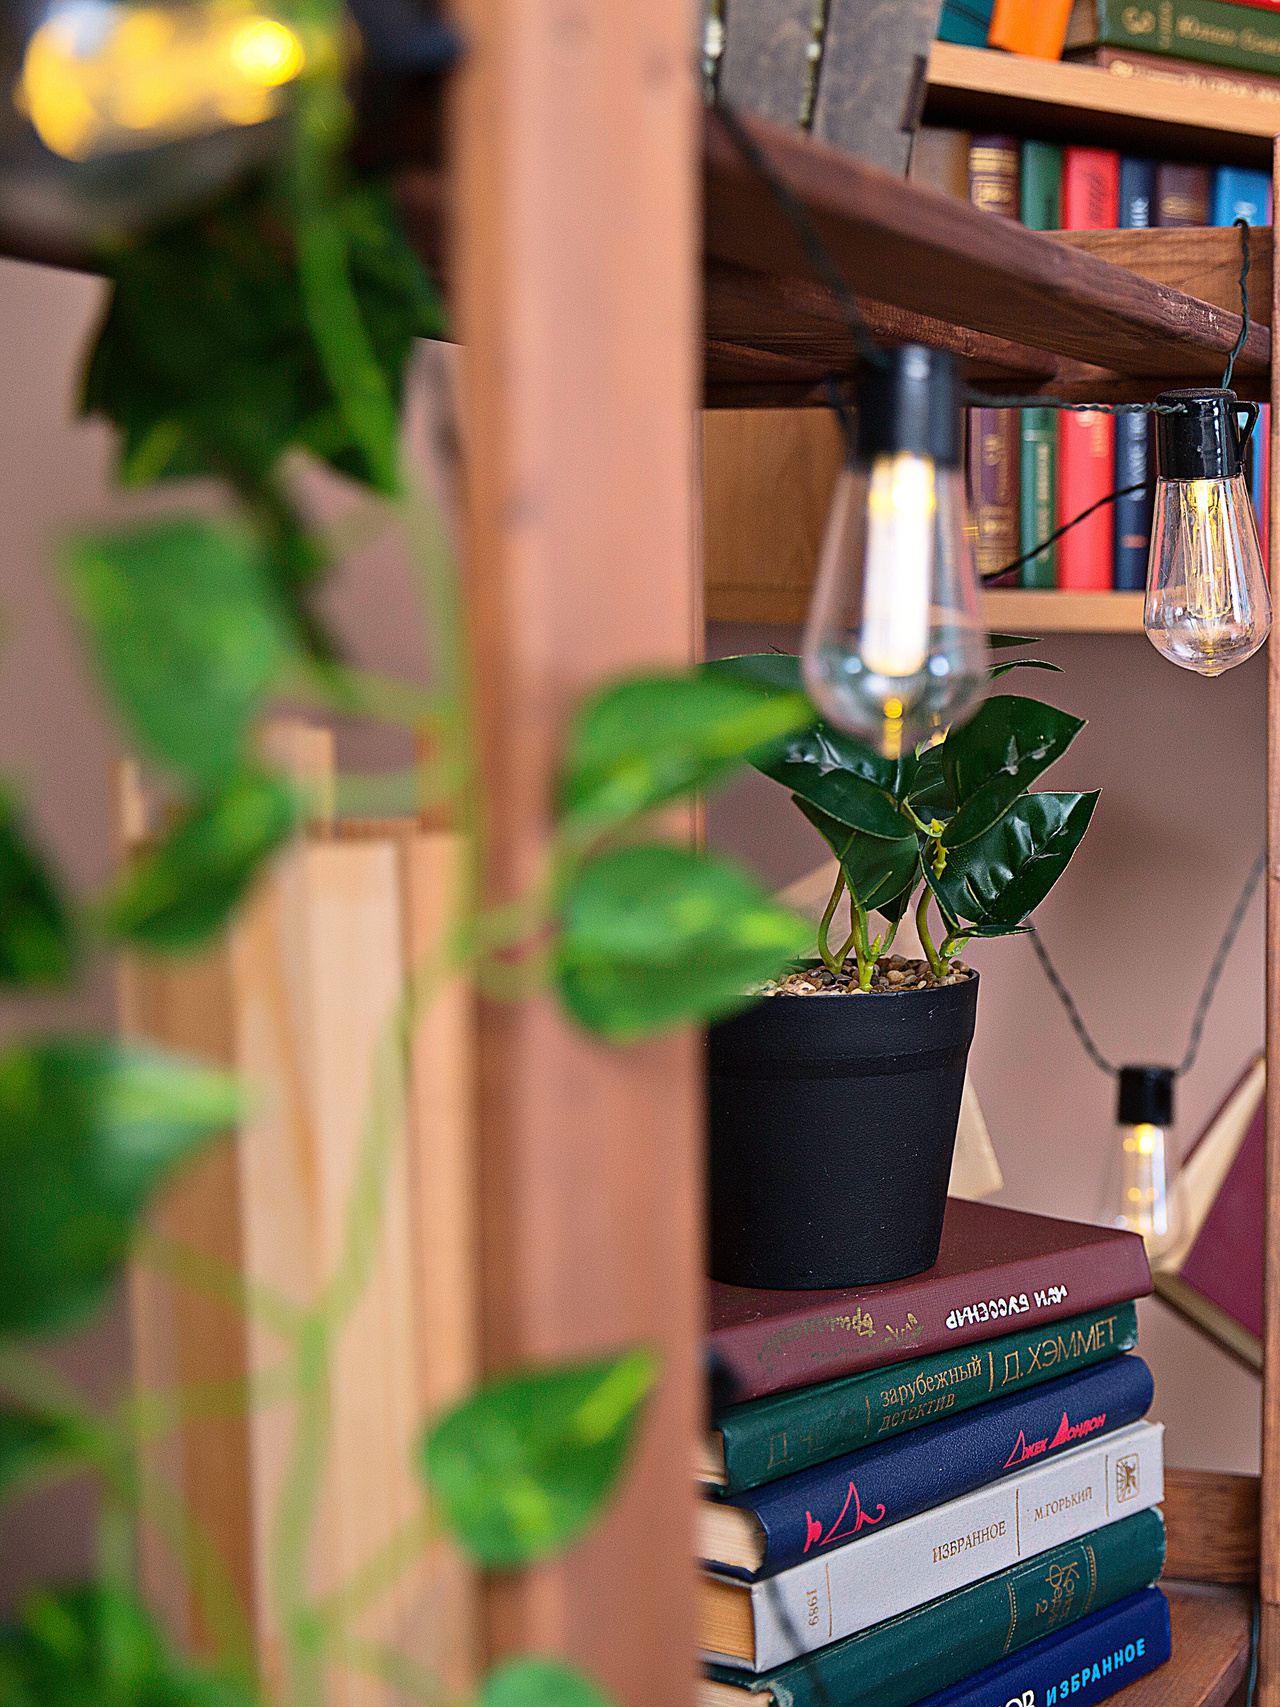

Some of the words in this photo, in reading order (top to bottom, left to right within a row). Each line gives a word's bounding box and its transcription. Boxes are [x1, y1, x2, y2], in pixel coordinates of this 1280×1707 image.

[945, 1293, 1030, 1331] БУССЕНАР
[1027, 1316, 1117, 1375] ХЭММЕТ
[880, 1354, 982, 1407] зарубежный
[932, 1520, 1007, 1563] ИЗБРАННОЕ
[806, 1590, 819, 1627] 1989
[1045, 1638, 1146, 1707] ИЗБРАННОЕ
